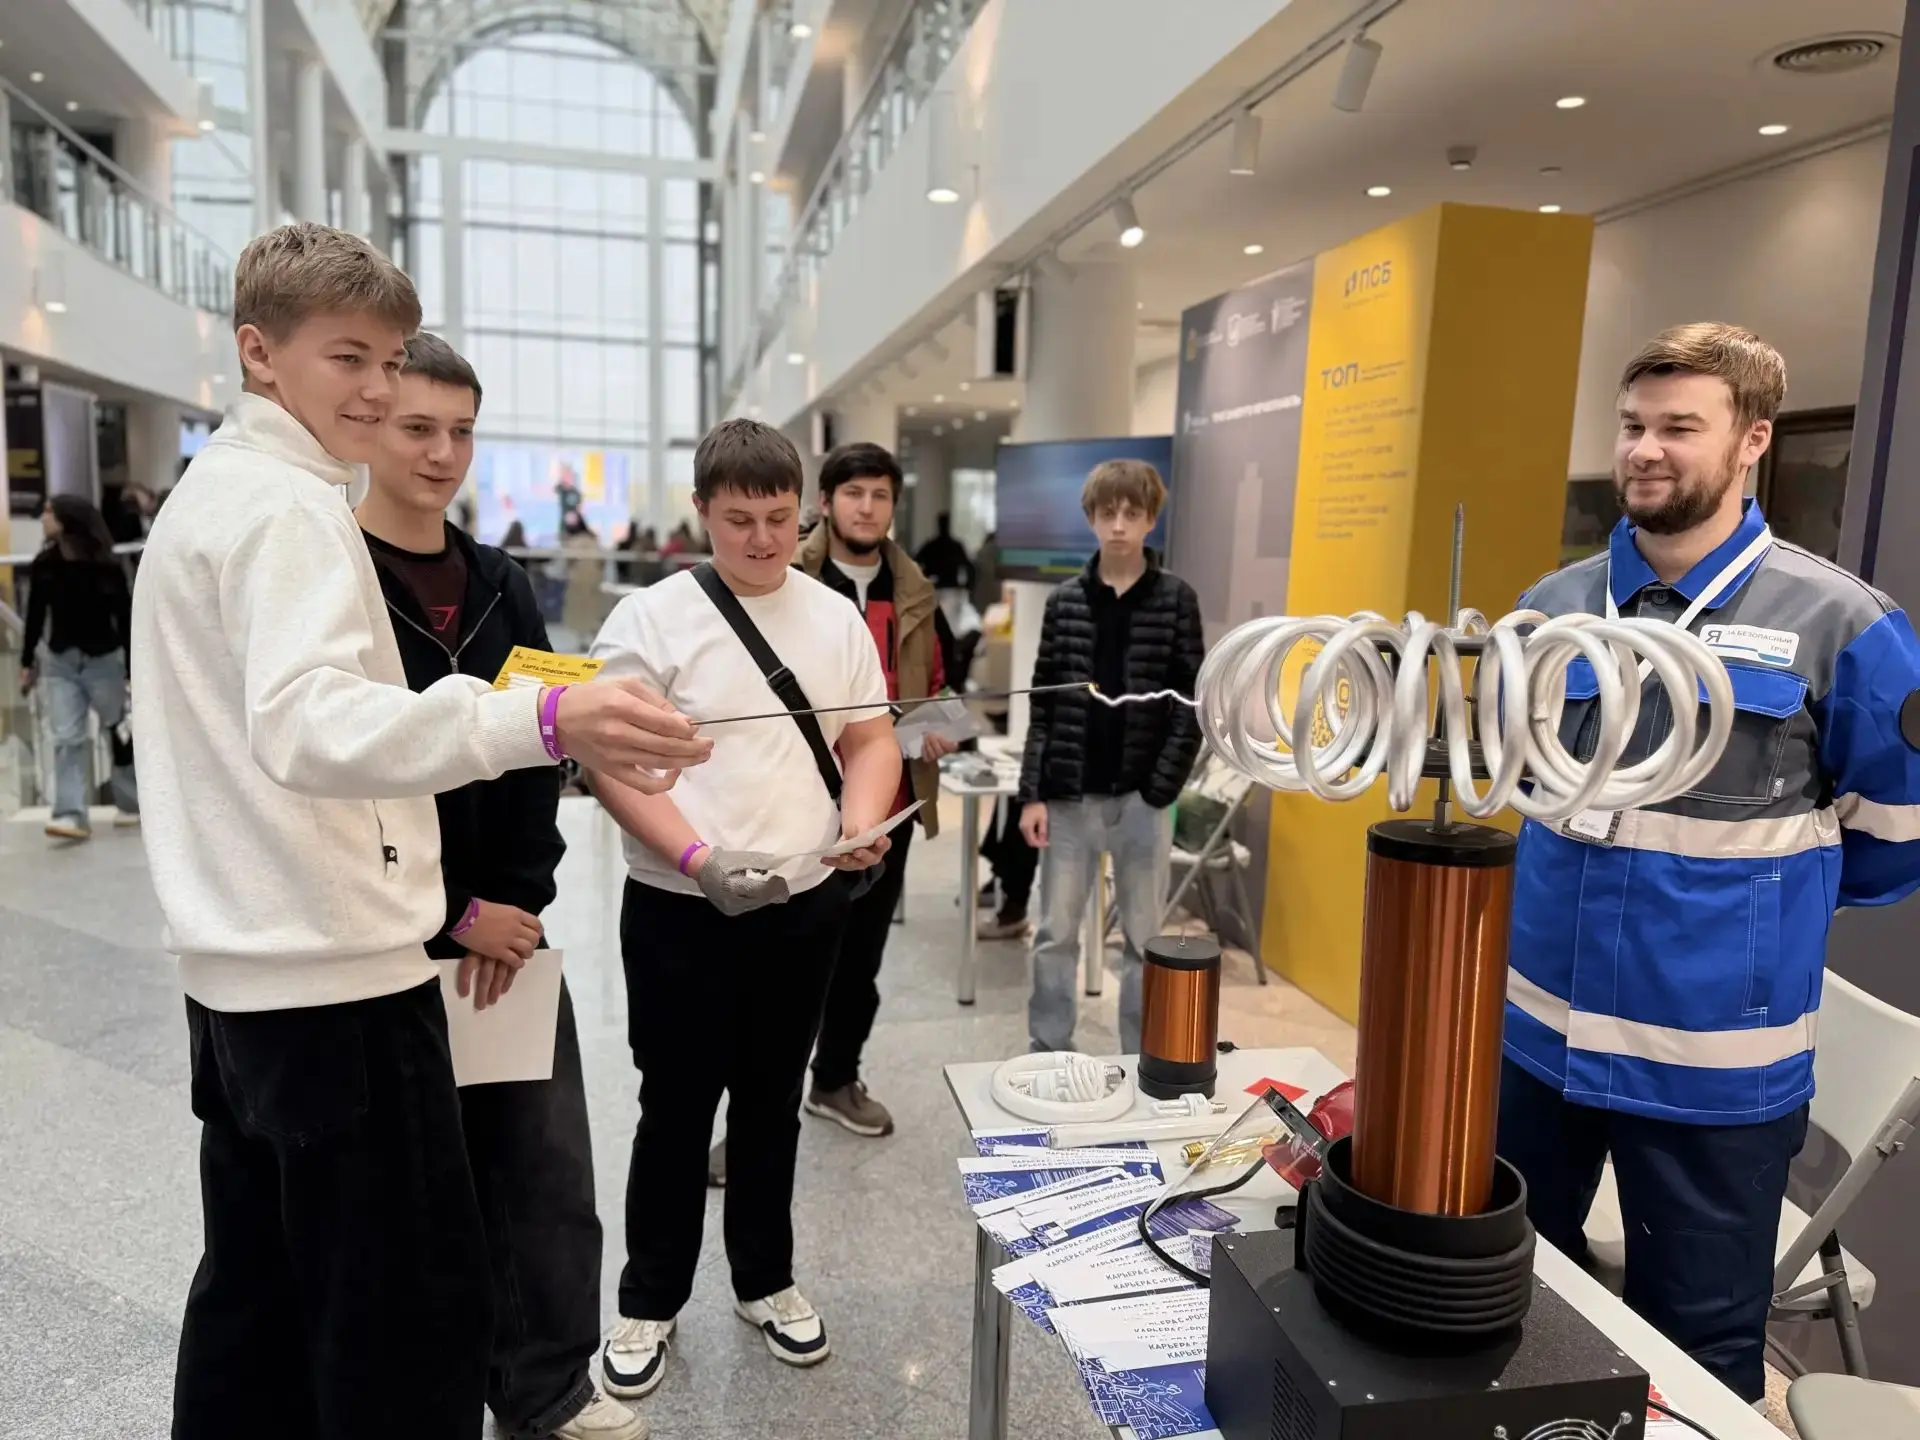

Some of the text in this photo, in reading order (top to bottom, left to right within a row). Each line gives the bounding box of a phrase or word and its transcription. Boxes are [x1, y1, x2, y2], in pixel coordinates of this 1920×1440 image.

[1360, 260, 1392, 293] ПСБ
[1321, 362, 1358, 390] ТОП
[1705, 630, 1722, 643] Я
[1770, 645, 1789, 655] ТРУД
[1106, 1269, 1142, 1281] КАРЬЕРА
[1113, 1280, 1152, 1290] КАРЬЕРА
[1149, 1342, 1190, 1350] КАРЬЕРА
